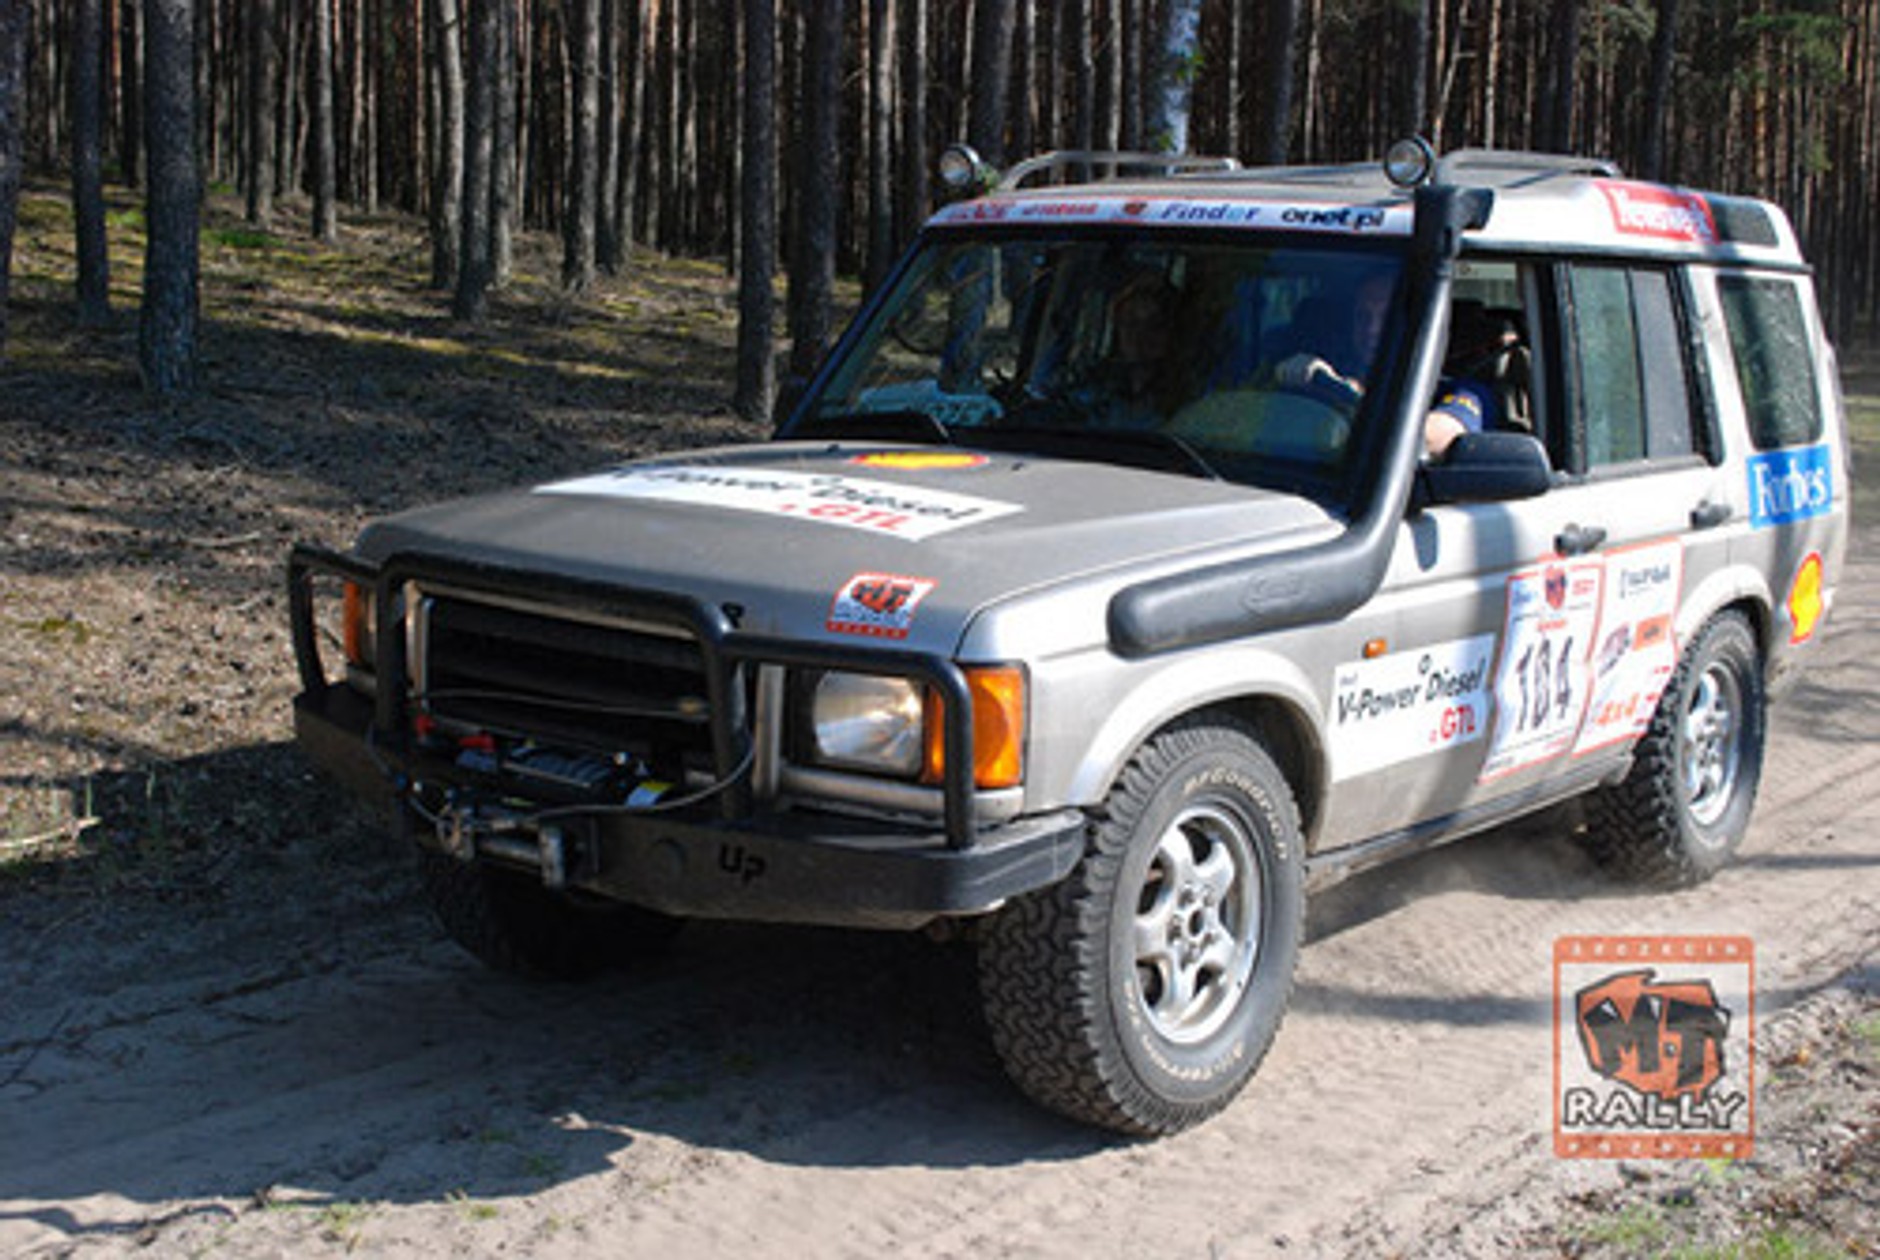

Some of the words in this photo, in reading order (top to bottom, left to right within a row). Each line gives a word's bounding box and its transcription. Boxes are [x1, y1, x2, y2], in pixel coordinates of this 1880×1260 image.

[1337, 684, 1422, 725] V-Power
[1425, 656, 1486, 701] Diesel
[1440, 703, 1476, 740] GTL
